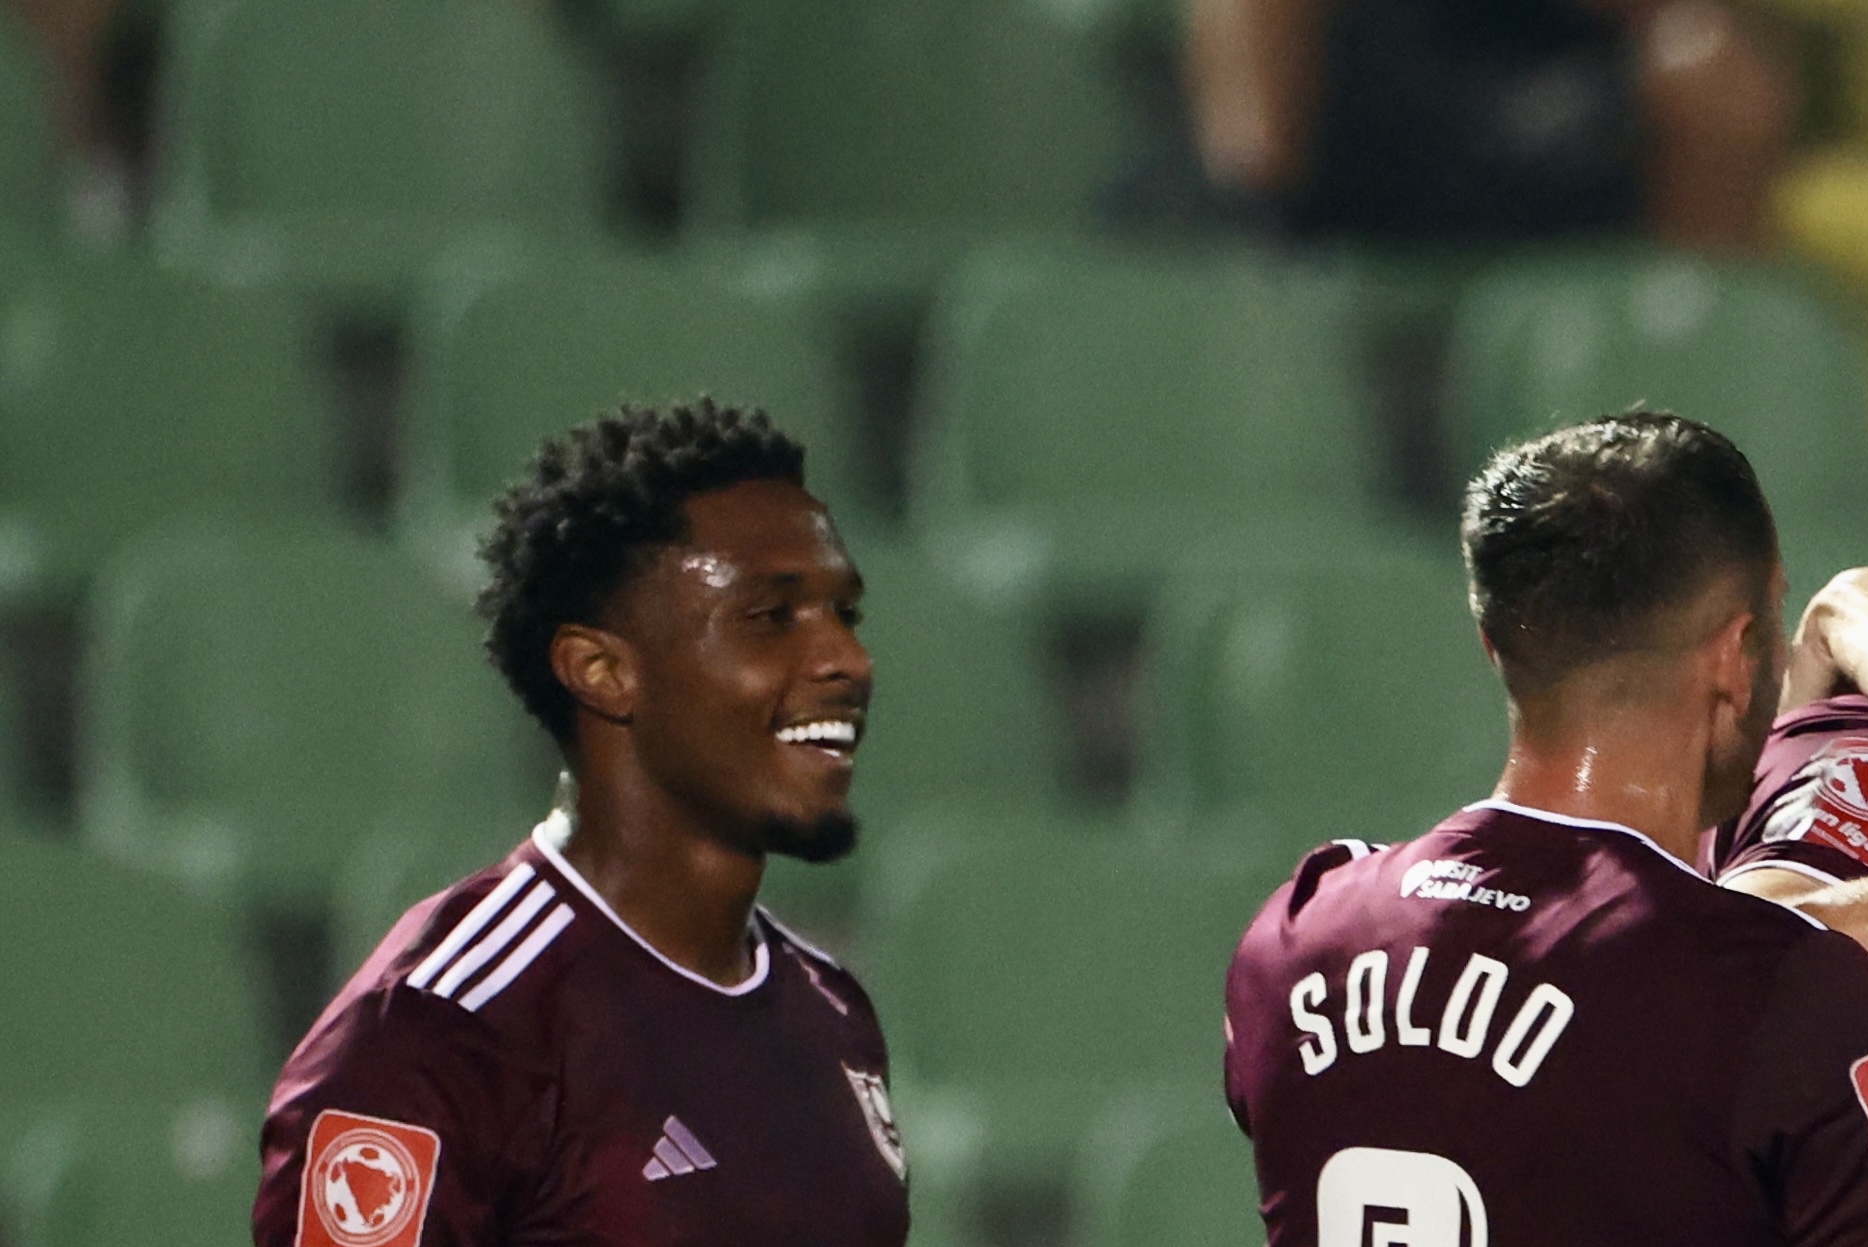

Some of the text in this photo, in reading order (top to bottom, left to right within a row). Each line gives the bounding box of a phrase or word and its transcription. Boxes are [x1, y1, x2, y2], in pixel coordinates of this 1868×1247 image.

[1430, 859, 1484, 882] VISIT
[1416, 879, 1531, 912] SARAJEVO
[1290, 946, 1575, 1088] SOLDO
